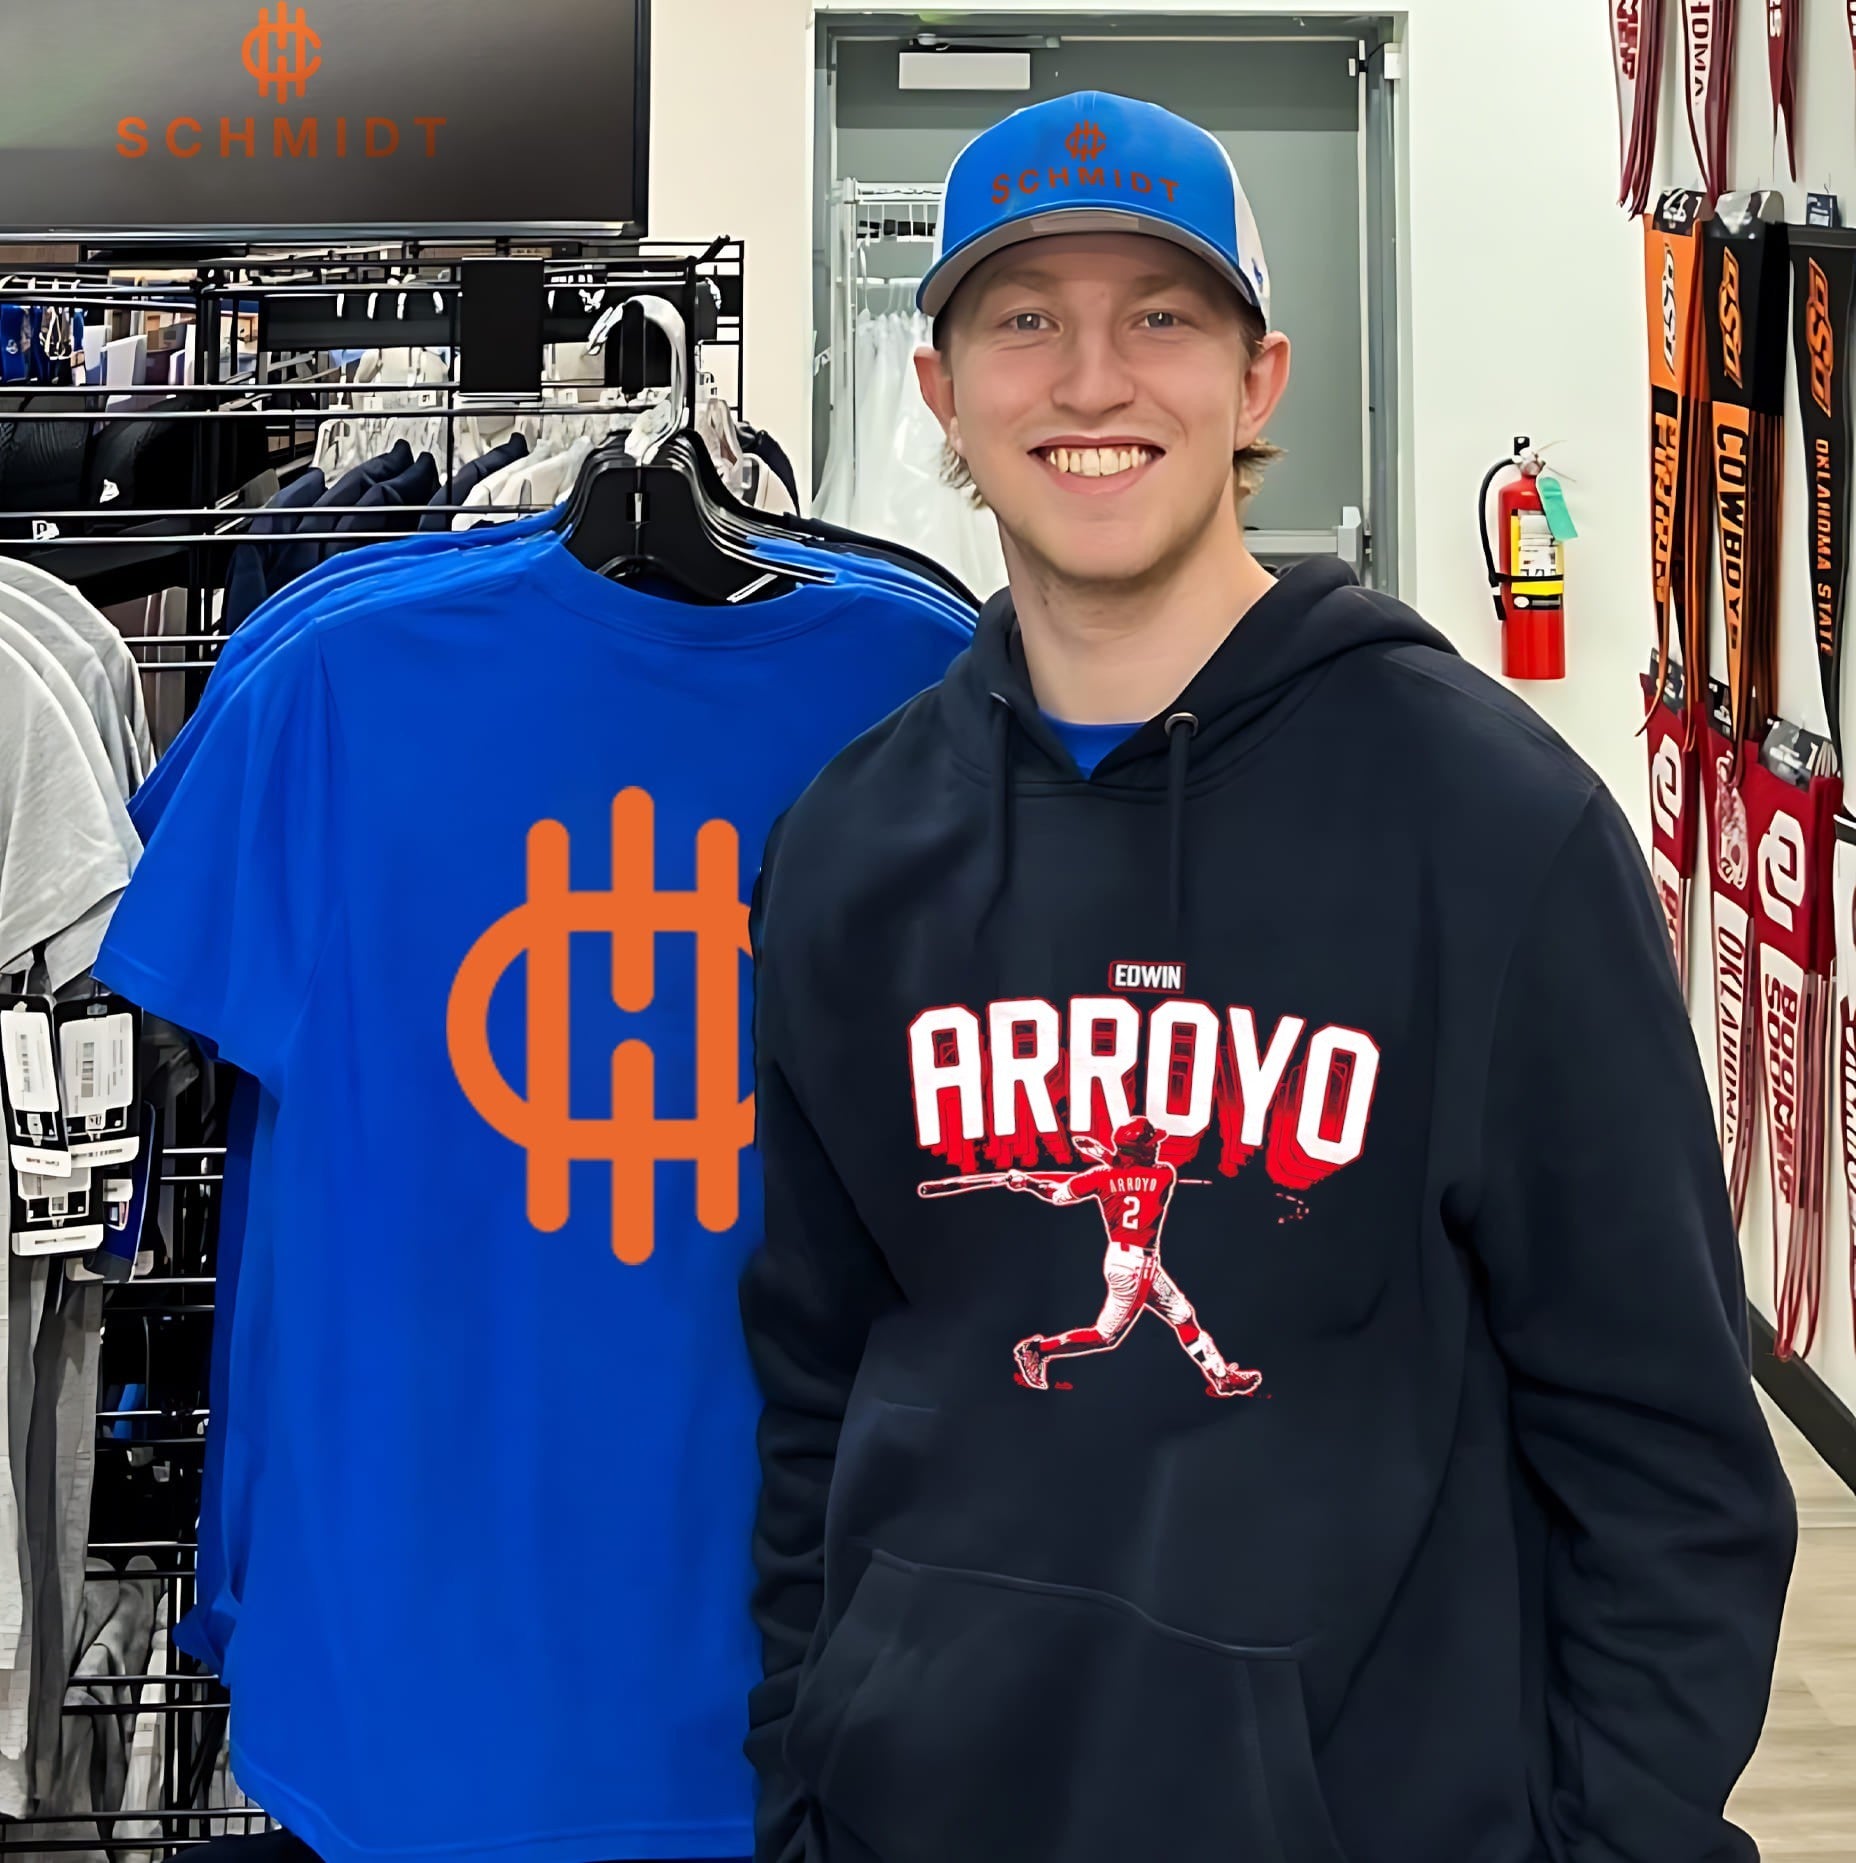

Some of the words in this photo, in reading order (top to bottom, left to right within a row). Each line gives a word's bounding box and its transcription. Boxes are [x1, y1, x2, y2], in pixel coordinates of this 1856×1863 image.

[116, 116, 448, 159] SCHMIDT
[991, 166, 1180, 205] SCHMIDT
[1815, 438, 1832, 571] OKLAHOMA
[1115, 963, 1182, 989] EDWIN
[1717, 925, 1745, 1145] OKLAHOMA
[908, 996, 1381, 1167] ARROYO
[1109, 1177, 1157, 1193] ARROYO
[1122, 1196, 1140, 1230] 2
